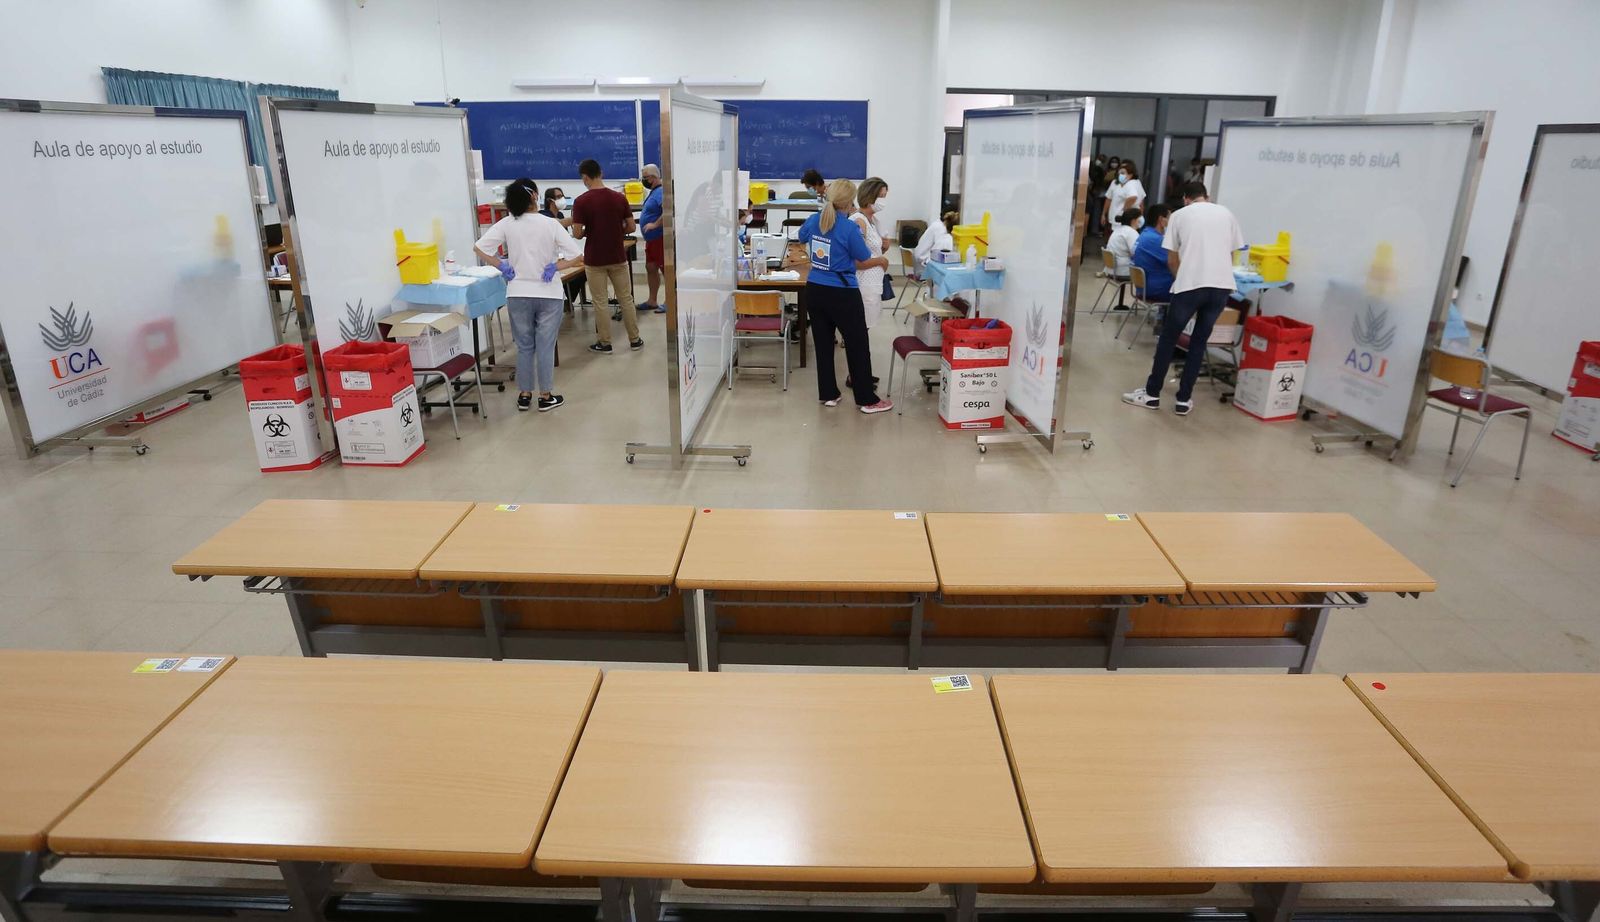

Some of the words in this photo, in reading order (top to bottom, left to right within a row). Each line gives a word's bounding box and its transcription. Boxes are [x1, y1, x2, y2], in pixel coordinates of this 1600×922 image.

[33, 140, 71, 158] Aula
[75, 140, 95, 157] de
[99, 143, 142, 159] apoyo
[145, 140, 157, 155] al
[160, 140, 203, 154] estudio
[324, 140, 350, 157] Aula
[353, 140, 367, 156] de
[369, 142, 399, 158] apoyo
[401, 139, 409, 154] al
[410, 139, 441, 154] estudio
[49, 348, 103, 379] UCA
[57, 375, 108, 400] Universidad
[67, 398, 79, 408] de
[80, 388, 105, 403] Cádiz
[963, 401, 990, 410] cespa
